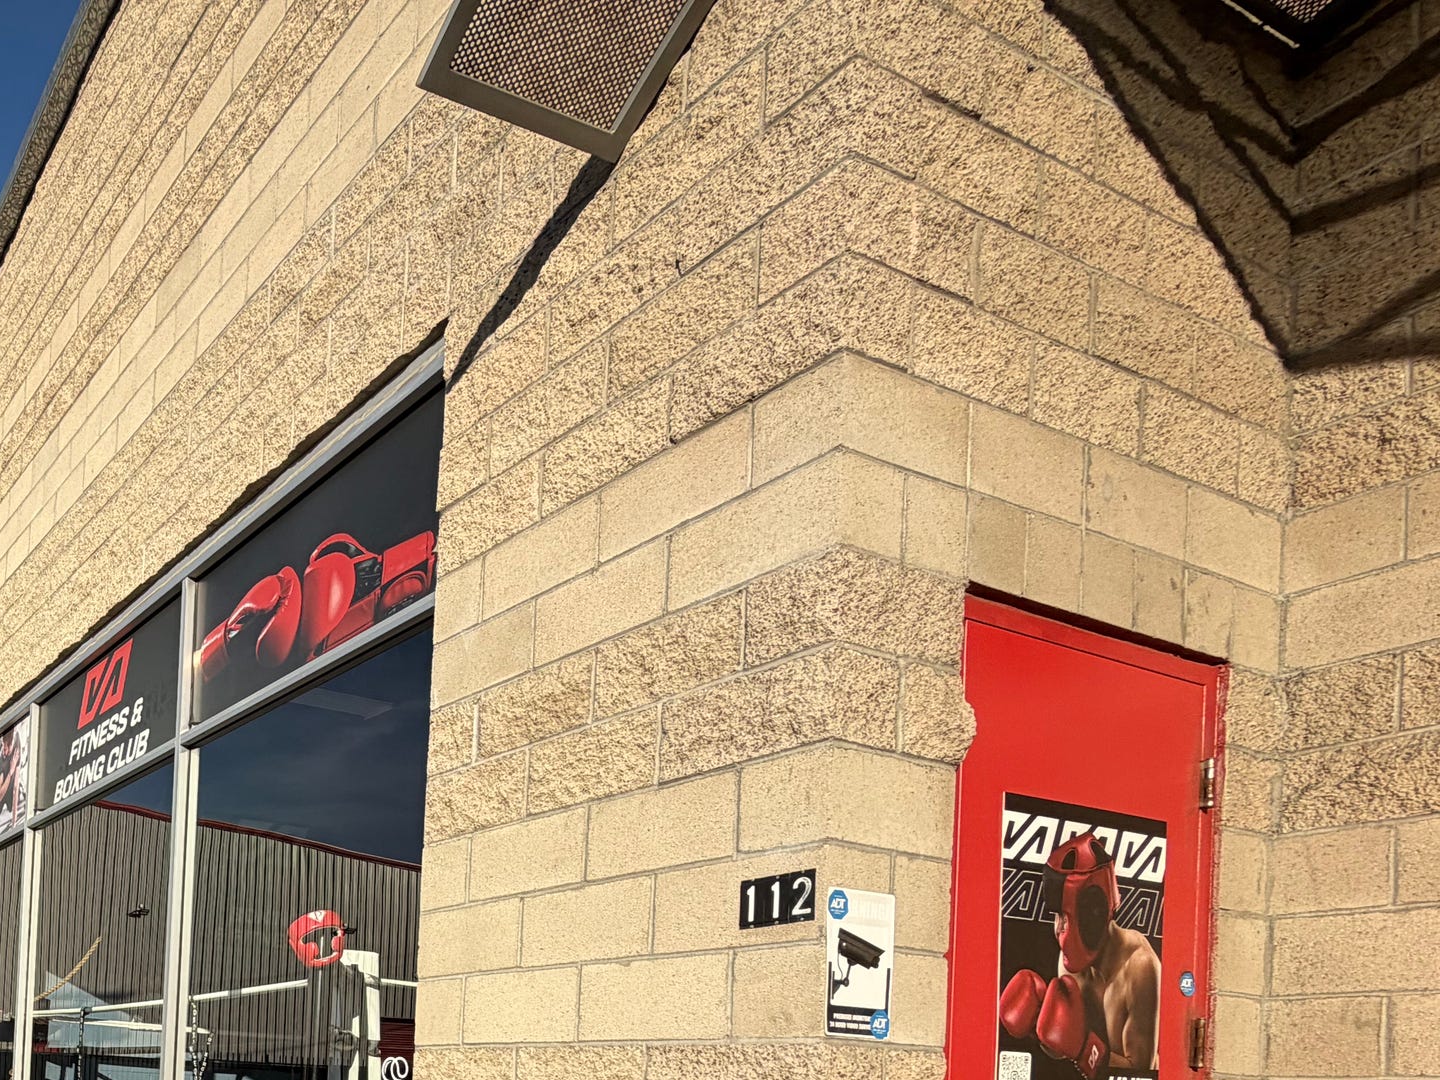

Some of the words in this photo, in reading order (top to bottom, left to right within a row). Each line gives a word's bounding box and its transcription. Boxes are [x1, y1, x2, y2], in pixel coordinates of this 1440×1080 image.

[68, 705, 130, 766] FITNESS
[130, 696, 144, 727] &
[53, 754, 105, 804] BOXING
[106, 728, 150, 775] CLUB
[746, 876, 812, 923] 112
[831, 897, 846, 910] ADT
[872, 1018, 888, 1030] ADT
